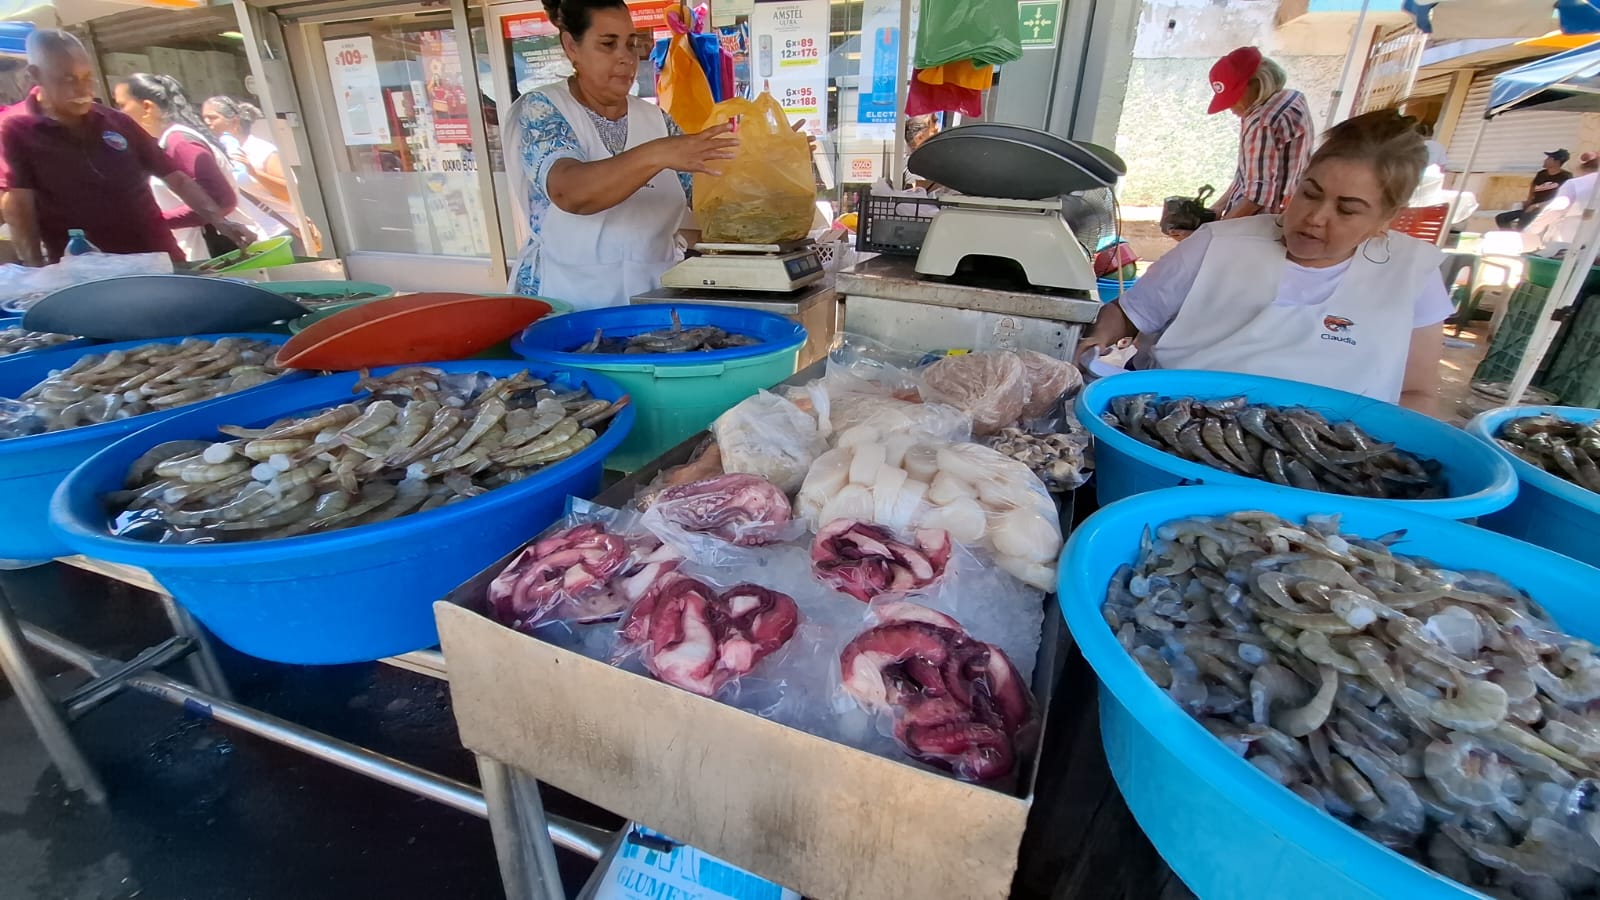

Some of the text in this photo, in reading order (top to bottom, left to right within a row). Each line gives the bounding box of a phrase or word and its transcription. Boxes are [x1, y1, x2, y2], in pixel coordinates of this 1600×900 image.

[773, 9, 803, 20] AMSTEL
[442, 159, 462, 172] OXXO
[1320, 333, 1357, 346] Claudia
